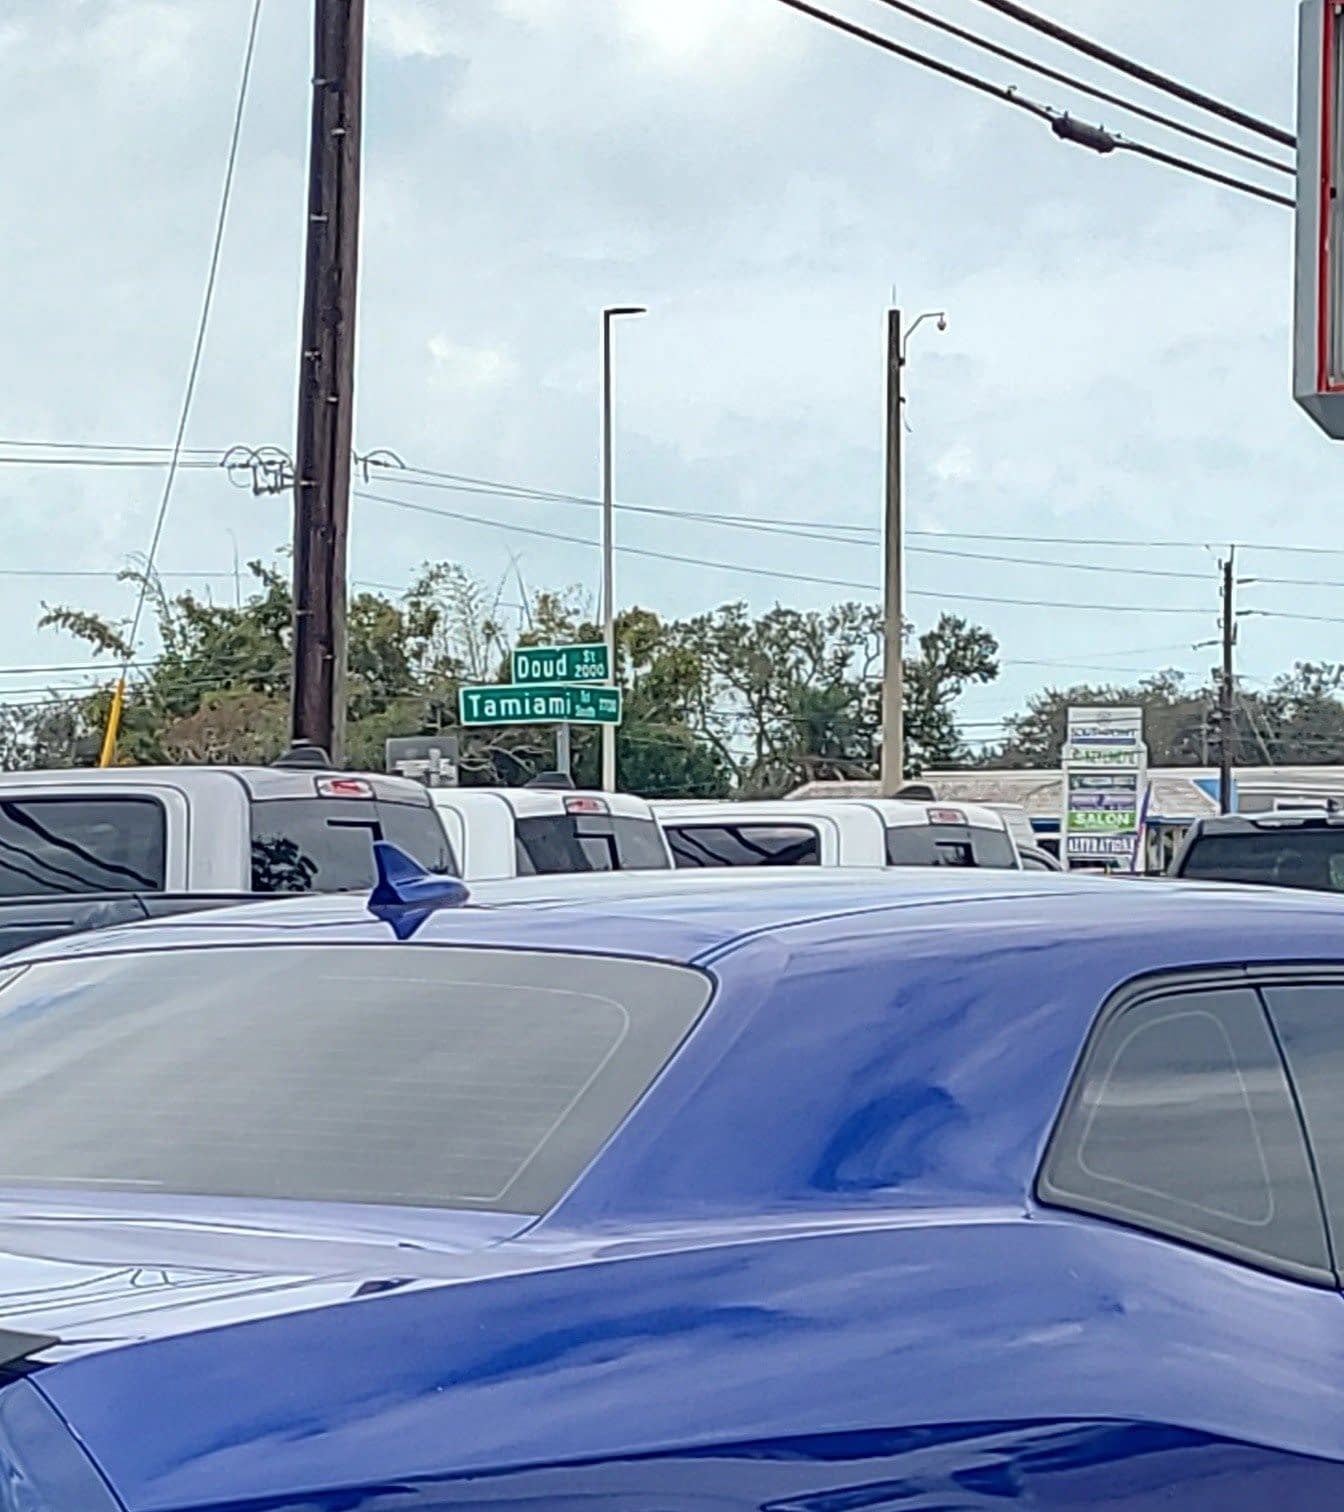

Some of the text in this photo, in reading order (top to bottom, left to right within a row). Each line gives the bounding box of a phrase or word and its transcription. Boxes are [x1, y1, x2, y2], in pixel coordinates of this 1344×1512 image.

[583, 650, 596, 663] St
[518, 653, 567, 679] Doud
[574, 664, 605, 678] 2000
[467, 692, 571, 718] Tamiami
[1074, 813, 1130, 825] SALON
